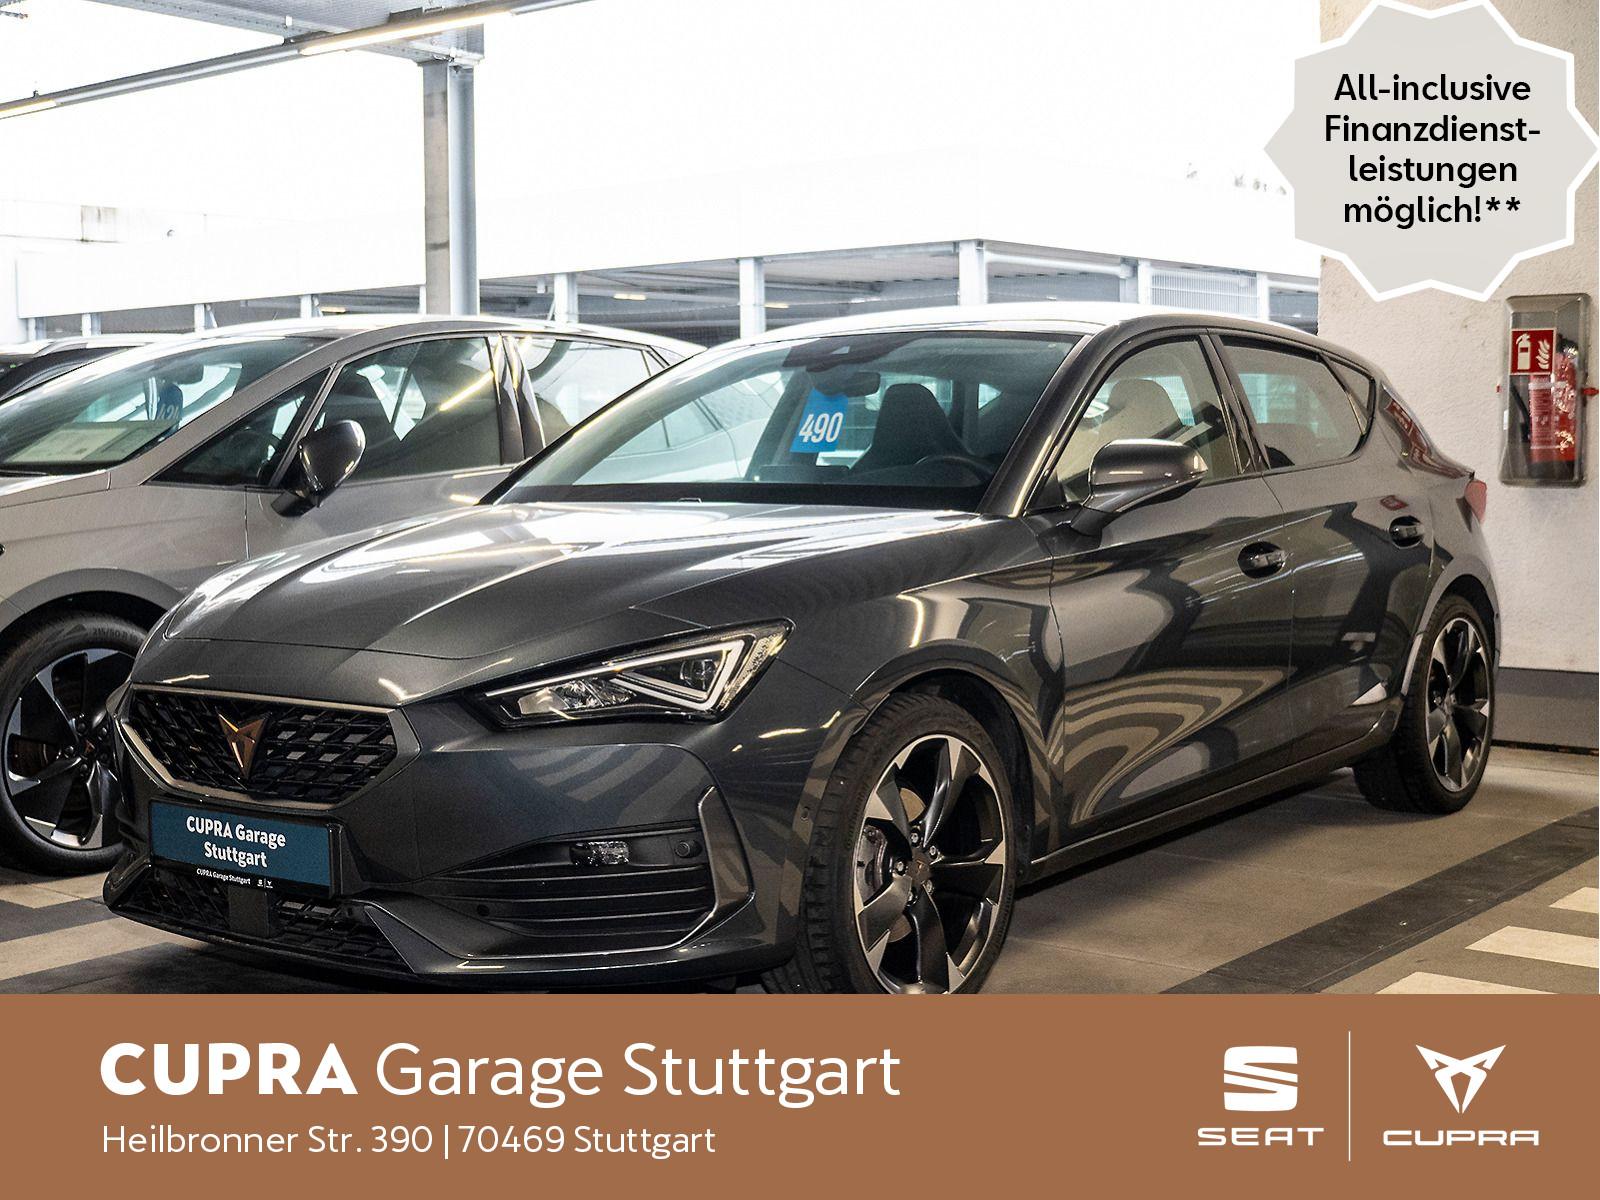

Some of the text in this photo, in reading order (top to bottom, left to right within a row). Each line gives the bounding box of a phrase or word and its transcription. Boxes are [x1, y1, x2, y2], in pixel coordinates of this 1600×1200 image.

[799, 412, 844, 444] 490
[186, 815, 286, 850] CUPRA Garage
[204, 841, 268, 868] Stuttgart
[196, 868, 251, 885] CUPRA Garage Stuttgart
